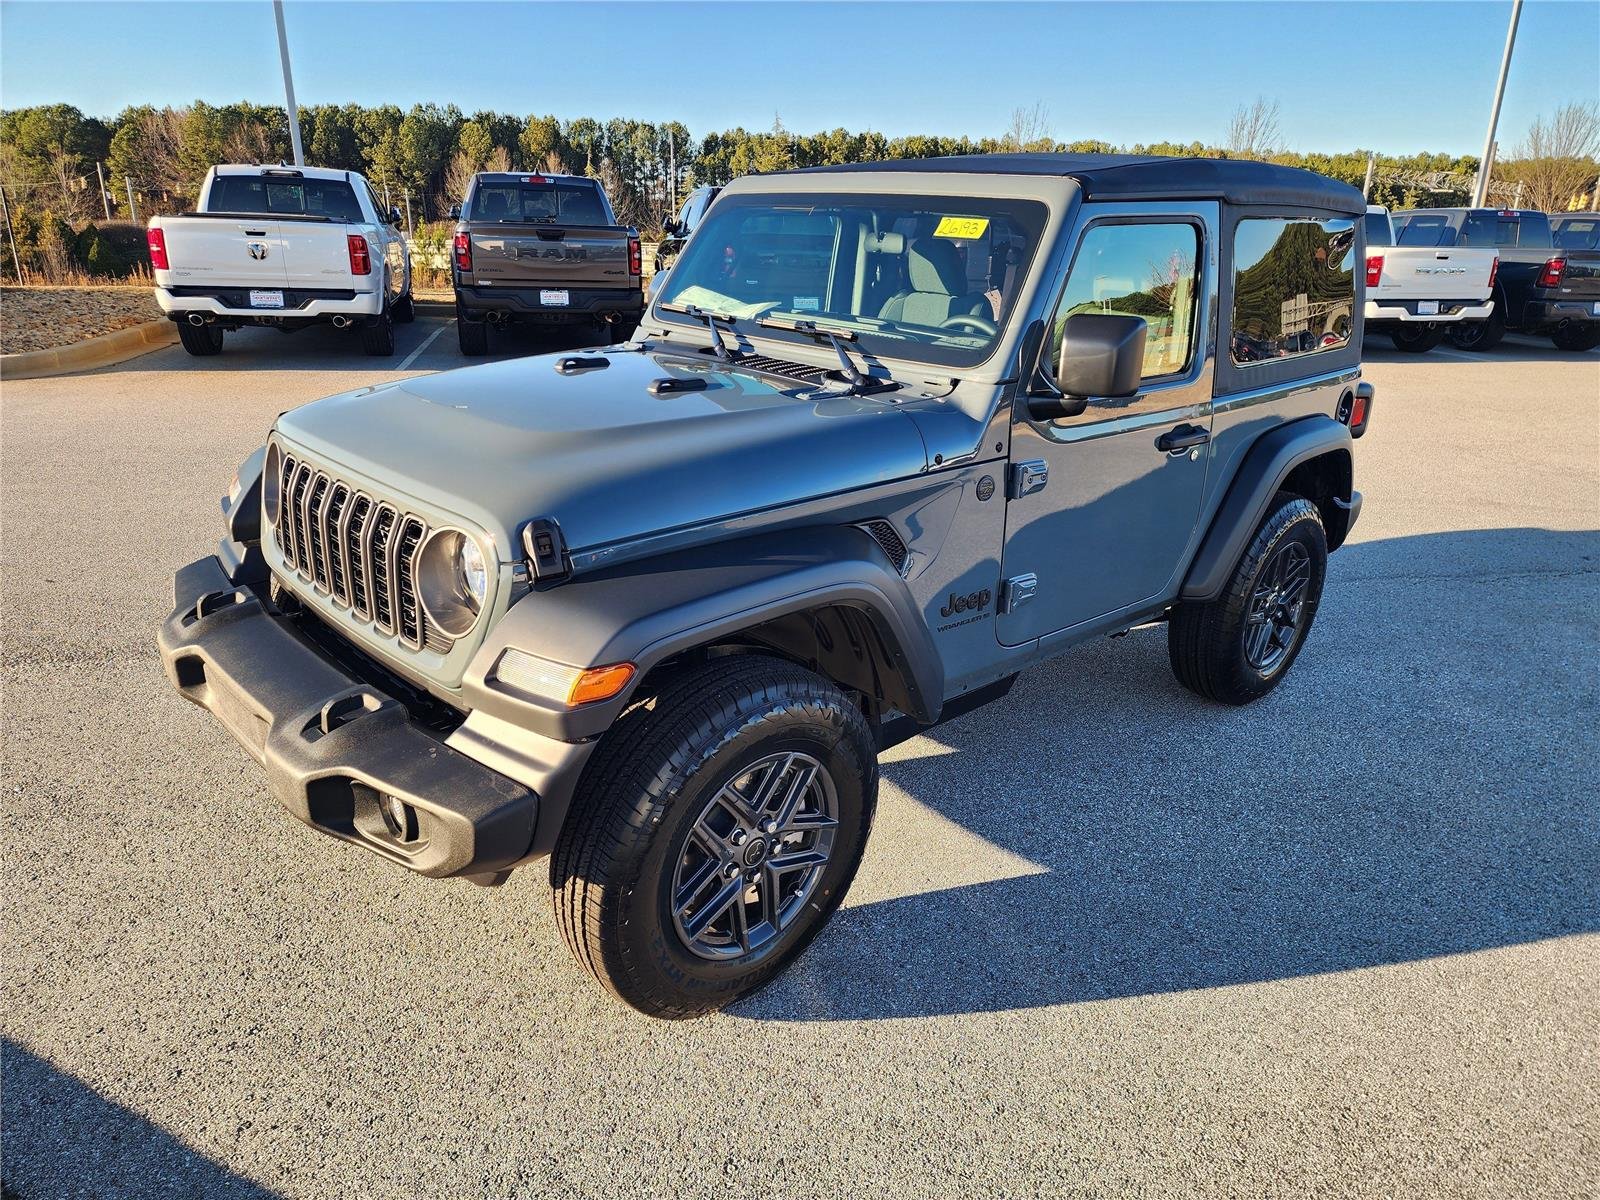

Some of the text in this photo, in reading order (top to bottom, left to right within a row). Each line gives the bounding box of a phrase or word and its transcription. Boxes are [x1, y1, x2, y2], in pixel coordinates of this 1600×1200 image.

[517, 248, 588, 260] RAM
[940, 588, 991, 618] Jeep
[936, 614, 982, 633] WRANGLER
